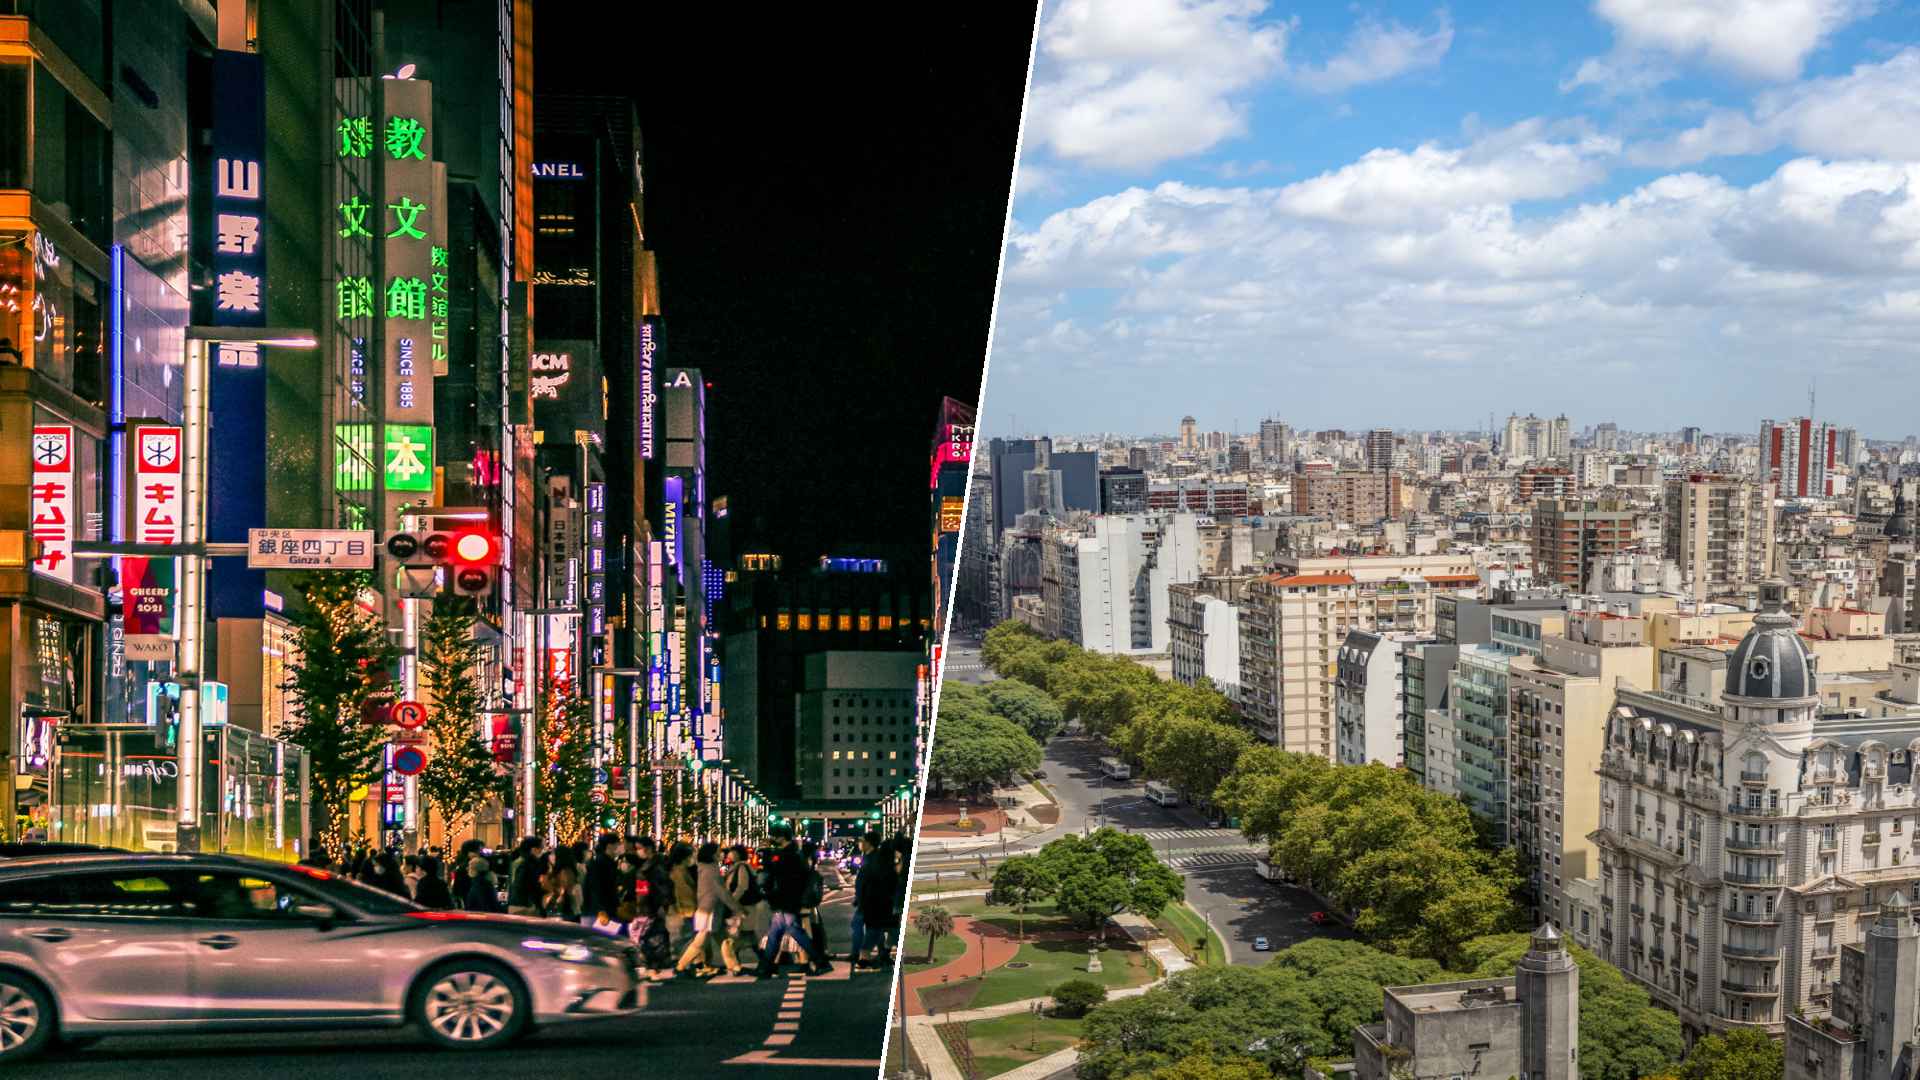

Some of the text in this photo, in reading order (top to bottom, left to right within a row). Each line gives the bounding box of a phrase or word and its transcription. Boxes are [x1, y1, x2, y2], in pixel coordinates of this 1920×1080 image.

[386, 116, 428, 319] 教文館
[400, 338, 414, 408] SINCE 1885
[386, 436, 427, 481] 本
[258, 530, 291, 539] 中央区
[258, 539, 365, 556] 銀座四丁目
[289, 555, 332, 565] Ginza 4
[130, 587, 169, 597] CHEERS
[137, 604, 163, 613] 2021
[133, 642, 169, 652] WAKO
